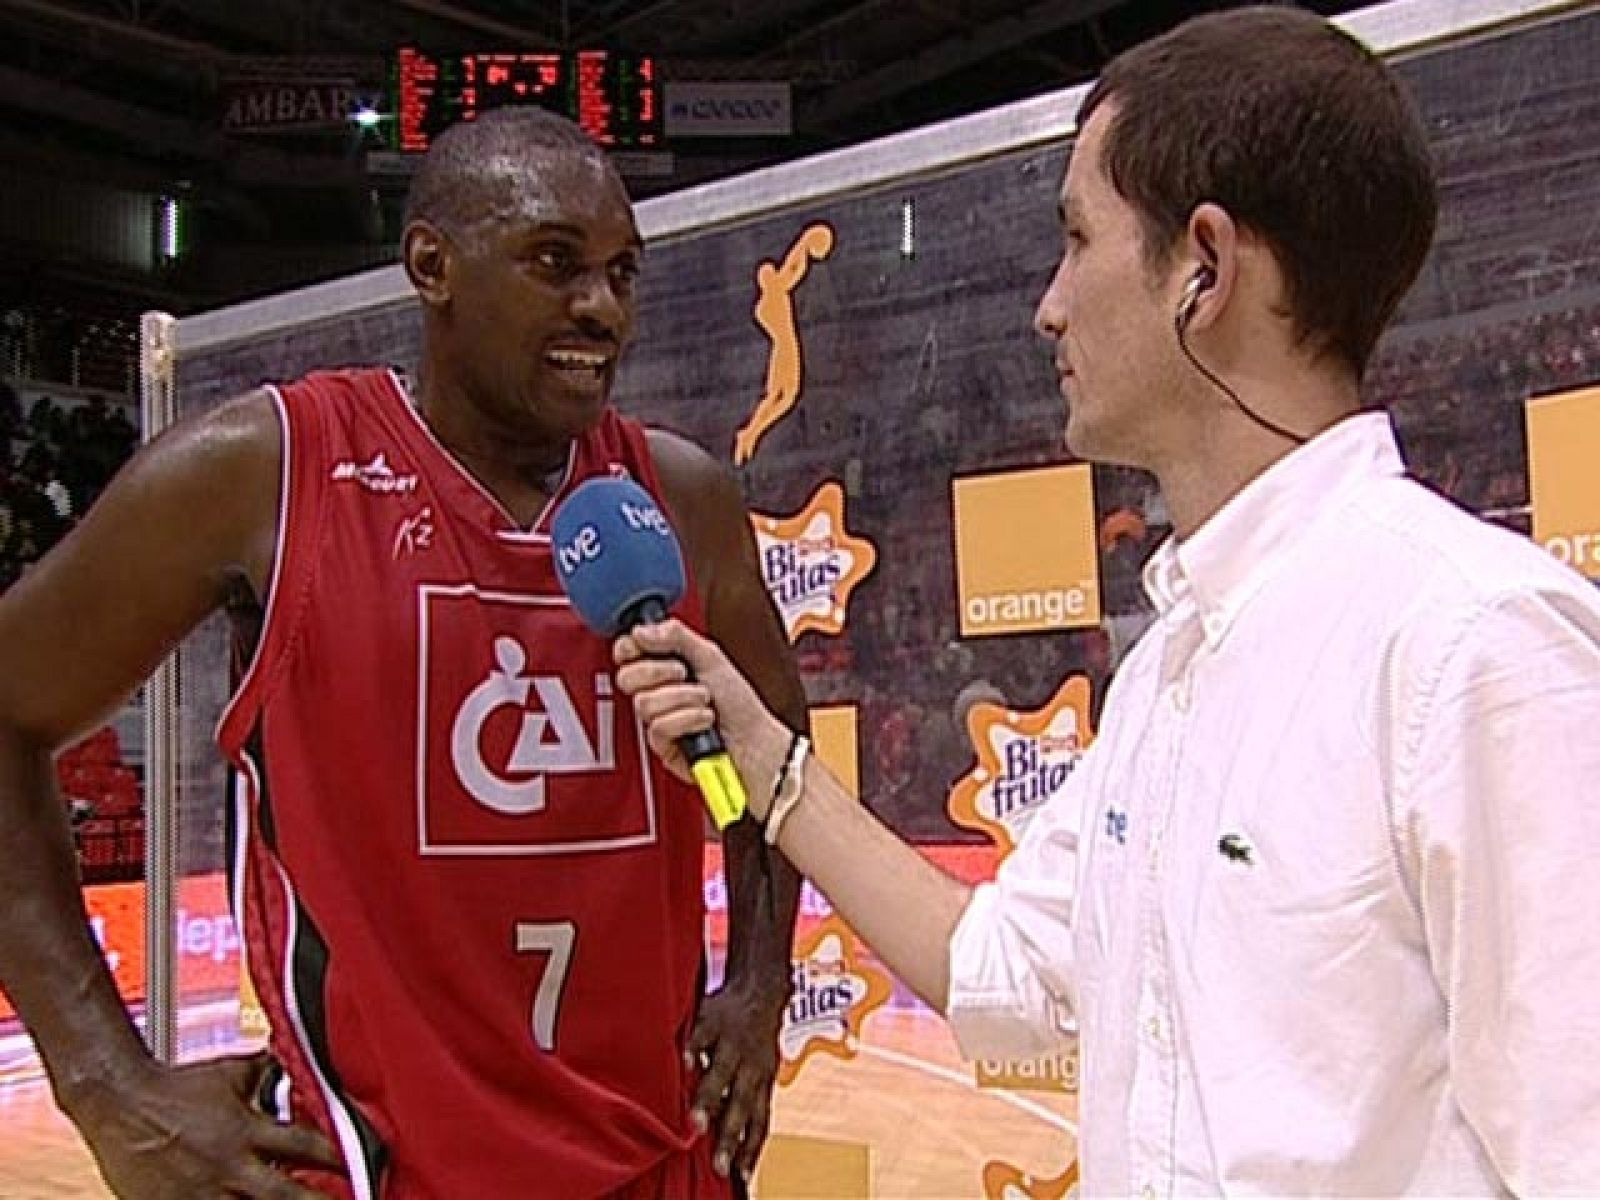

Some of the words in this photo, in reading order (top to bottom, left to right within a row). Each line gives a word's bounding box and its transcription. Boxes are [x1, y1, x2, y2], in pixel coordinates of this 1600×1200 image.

[621, 502, 669, 535] tve
[559, 526, 600, 573] tve
[765, 541, 796, 584] Bi
[966, 588, 1087, 626] orange
[1005, 738, 1037, 781] Bi
[515, 921, 576, 1050] 7
